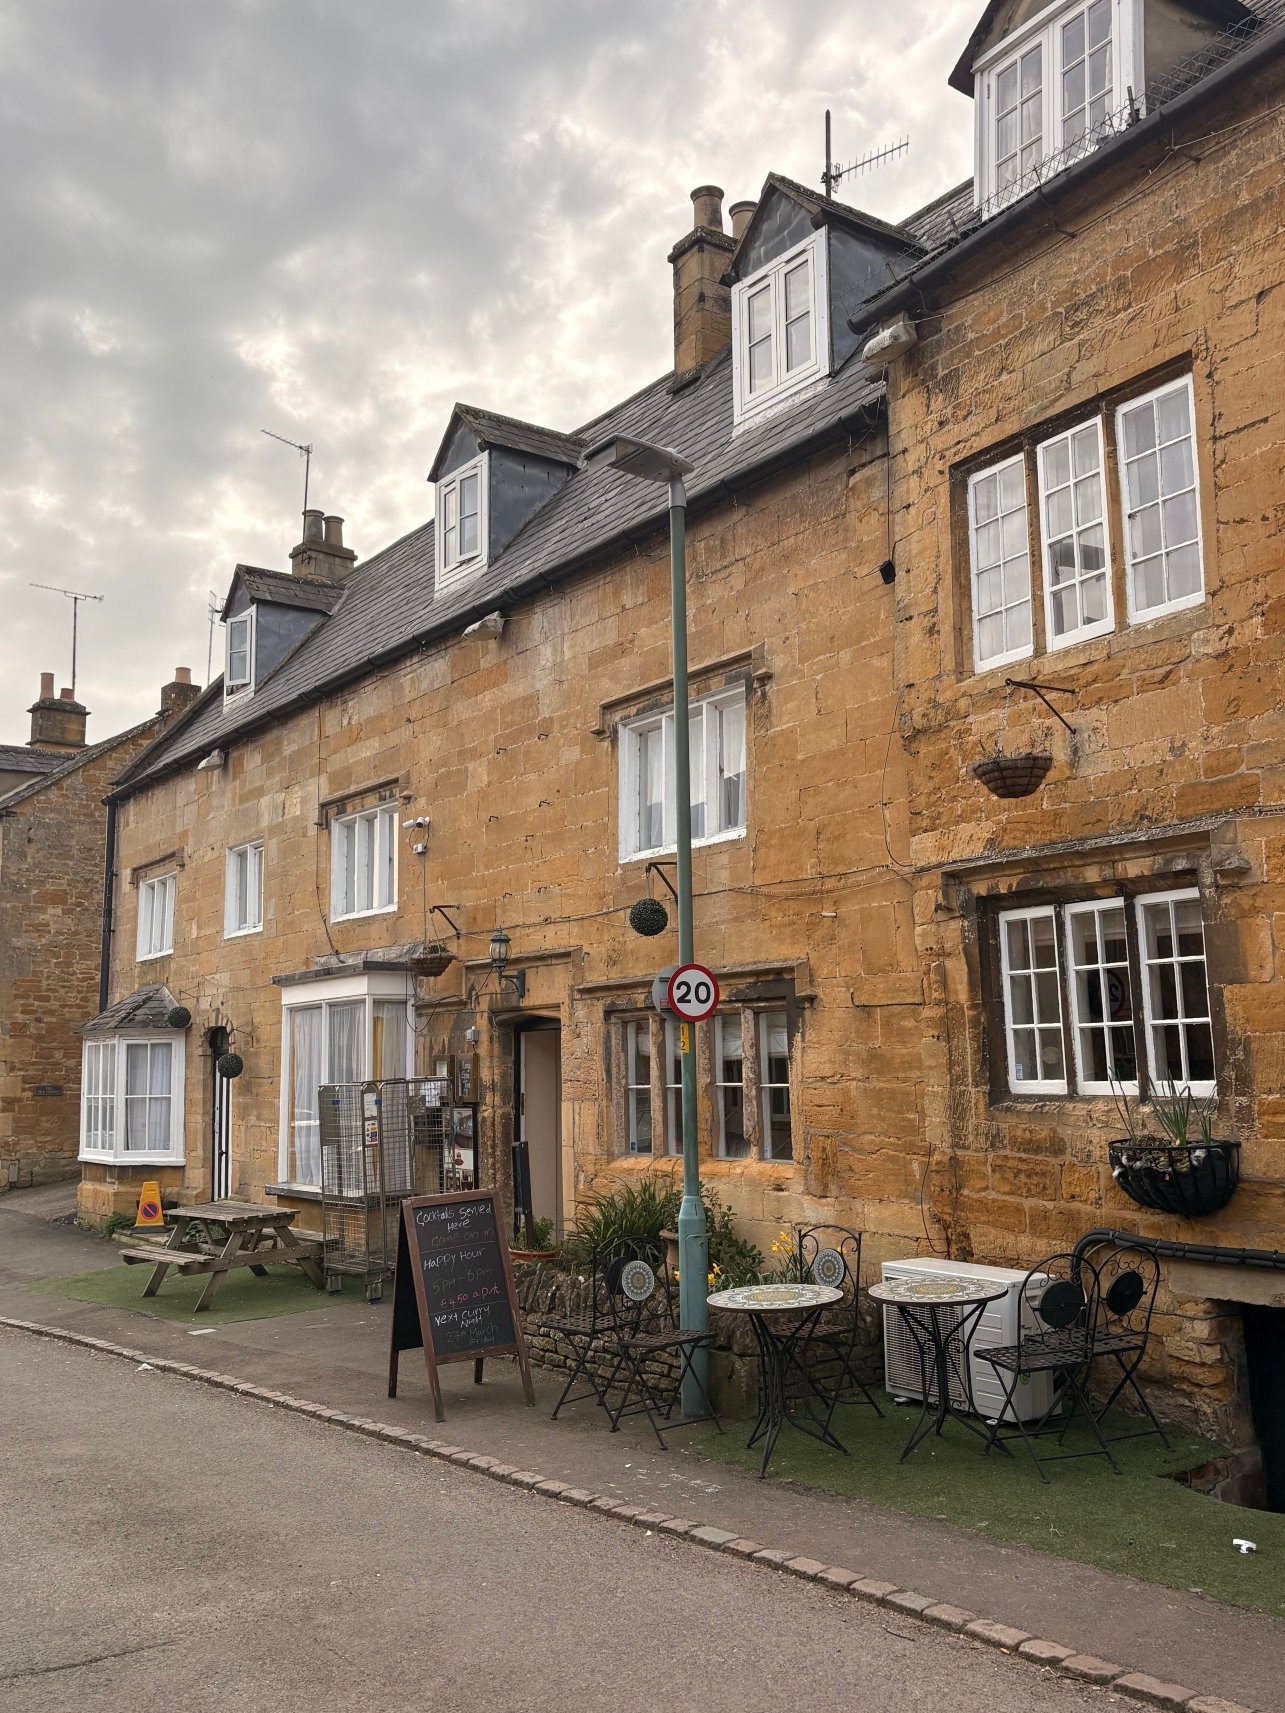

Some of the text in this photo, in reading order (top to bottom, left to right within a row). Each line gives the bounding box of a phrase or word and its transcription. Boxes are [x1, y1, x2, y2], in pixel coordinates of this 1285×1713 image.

[676, 981, 711, 1004] 20
[416, 1203, 493, 1226] Cocktails Served
[447, 1218, 471, 1233] Here
[463, 1231, 480, 1241] on
[424, 1248, 486, 1272] Happy Hour
[461, 1305, 490, 1320] Curry
